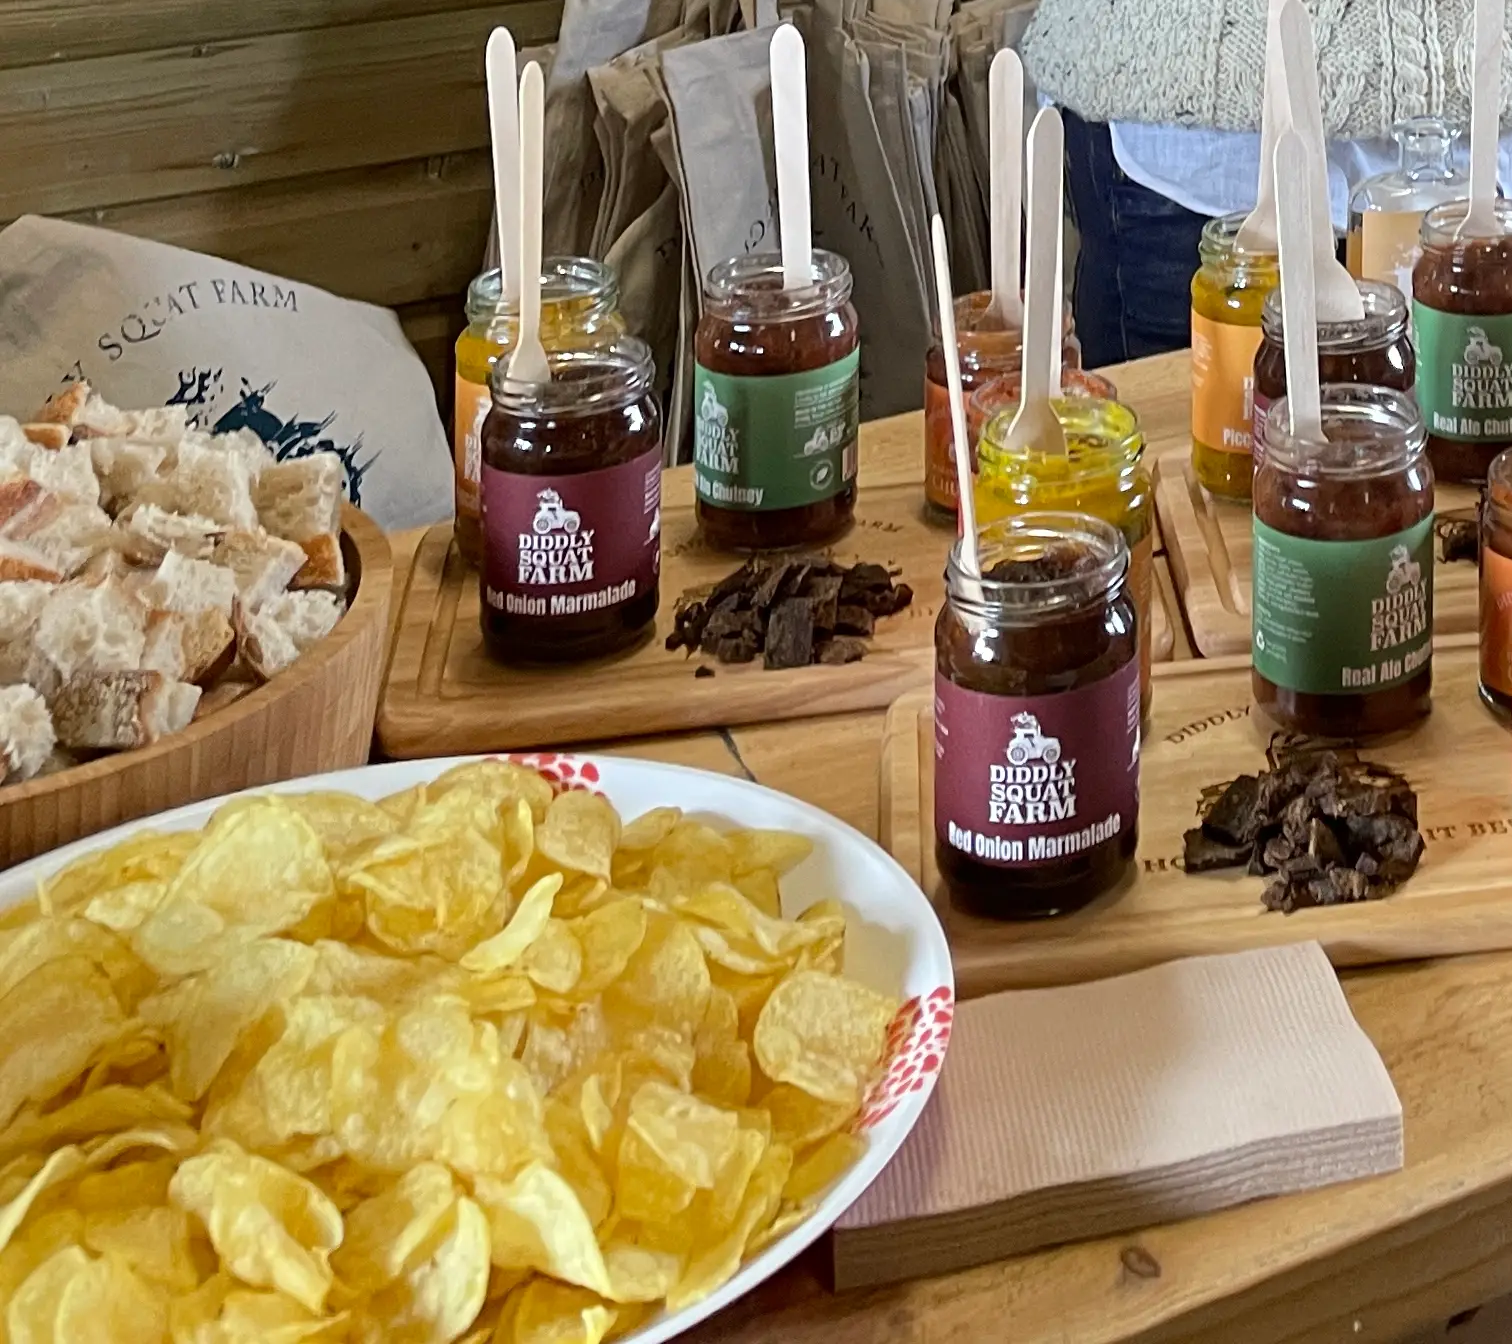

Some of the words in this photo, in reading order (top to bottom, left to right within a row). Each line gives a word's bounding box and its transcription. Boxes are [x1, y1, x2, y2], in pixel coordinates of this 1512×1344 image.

[97, 280, 201, 362] SQUAT
[210, 278, 299, 313] FARM
[1433, 410, 1458, 434] Real
[1460, 416, 1481, 437] Ale
[712, 478, 764, 507] Chutney
[518, 529, 595, 551] DIDDLY
[518, 545, 594, 568] SQUAT
[517, 561, 595, 585] FARM
[506, 592, 546, 616] Onion
[550, 578, 637, 616] Marmalade
[1371, 577, 1428, 616] DIDDLY
[1369, 613, 1428, 653] FARM
[1341, 663, 1377, 688] Real
[1380, 658, 1402, 683] Ale
[989, 757, 1077, 784] DIDDLY
[990, 777, 1076, 805] SQUAT
[988, 794, 1077, 825] FARM
[948, 819, 972, 854] Red
[974, 832, 1025, 862] Onion
[1028, 811, 1122, 862] Marmalade
